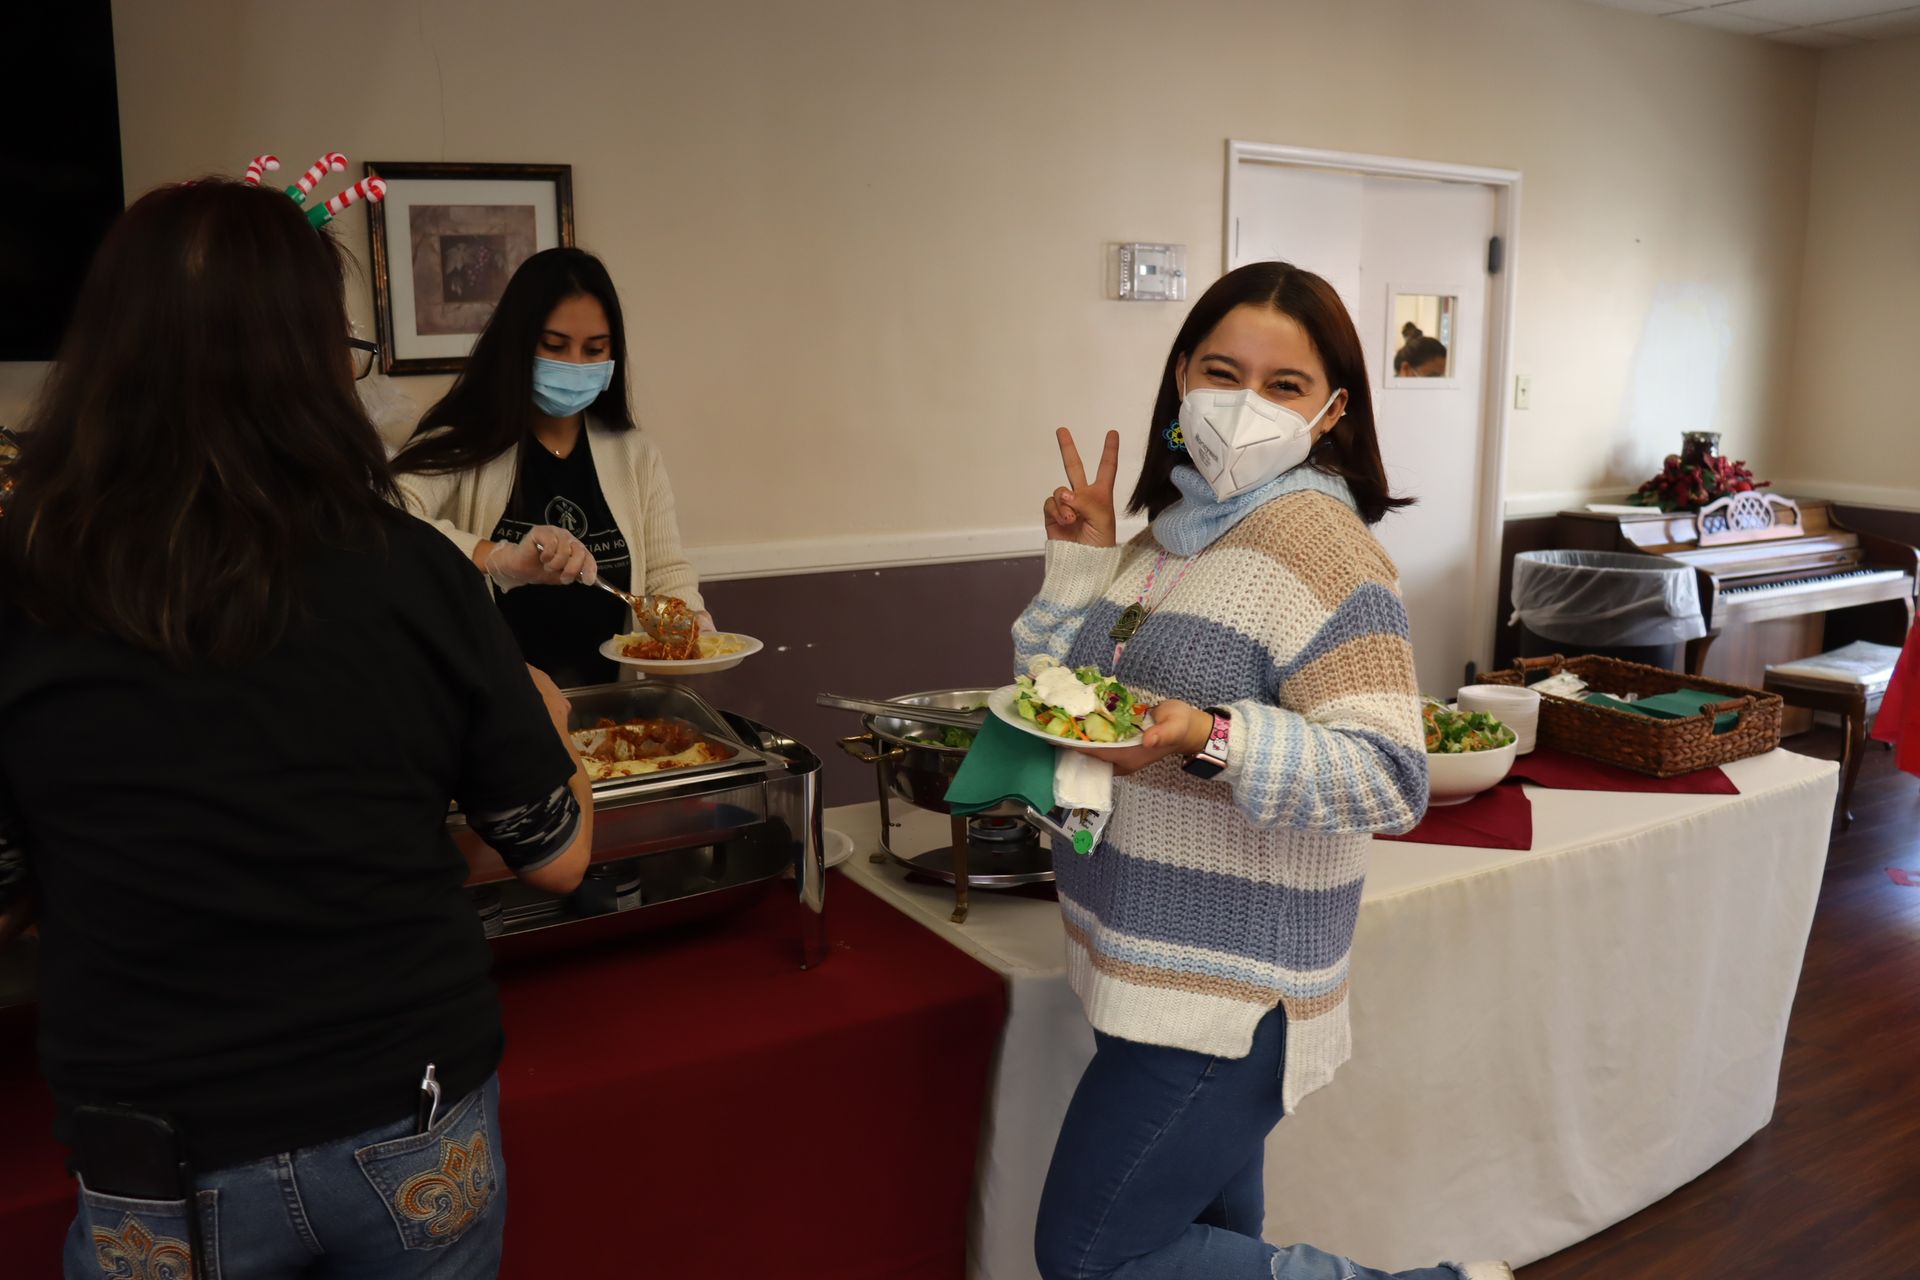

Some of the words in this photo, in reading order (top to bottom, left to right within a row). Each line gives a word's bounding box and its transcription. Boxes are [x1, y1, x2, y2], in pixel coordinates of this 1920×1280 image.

[496, 527, 523, 540] ART
[587, 541, 611, 553] IAN
[613, 539, 626, 550] HO
